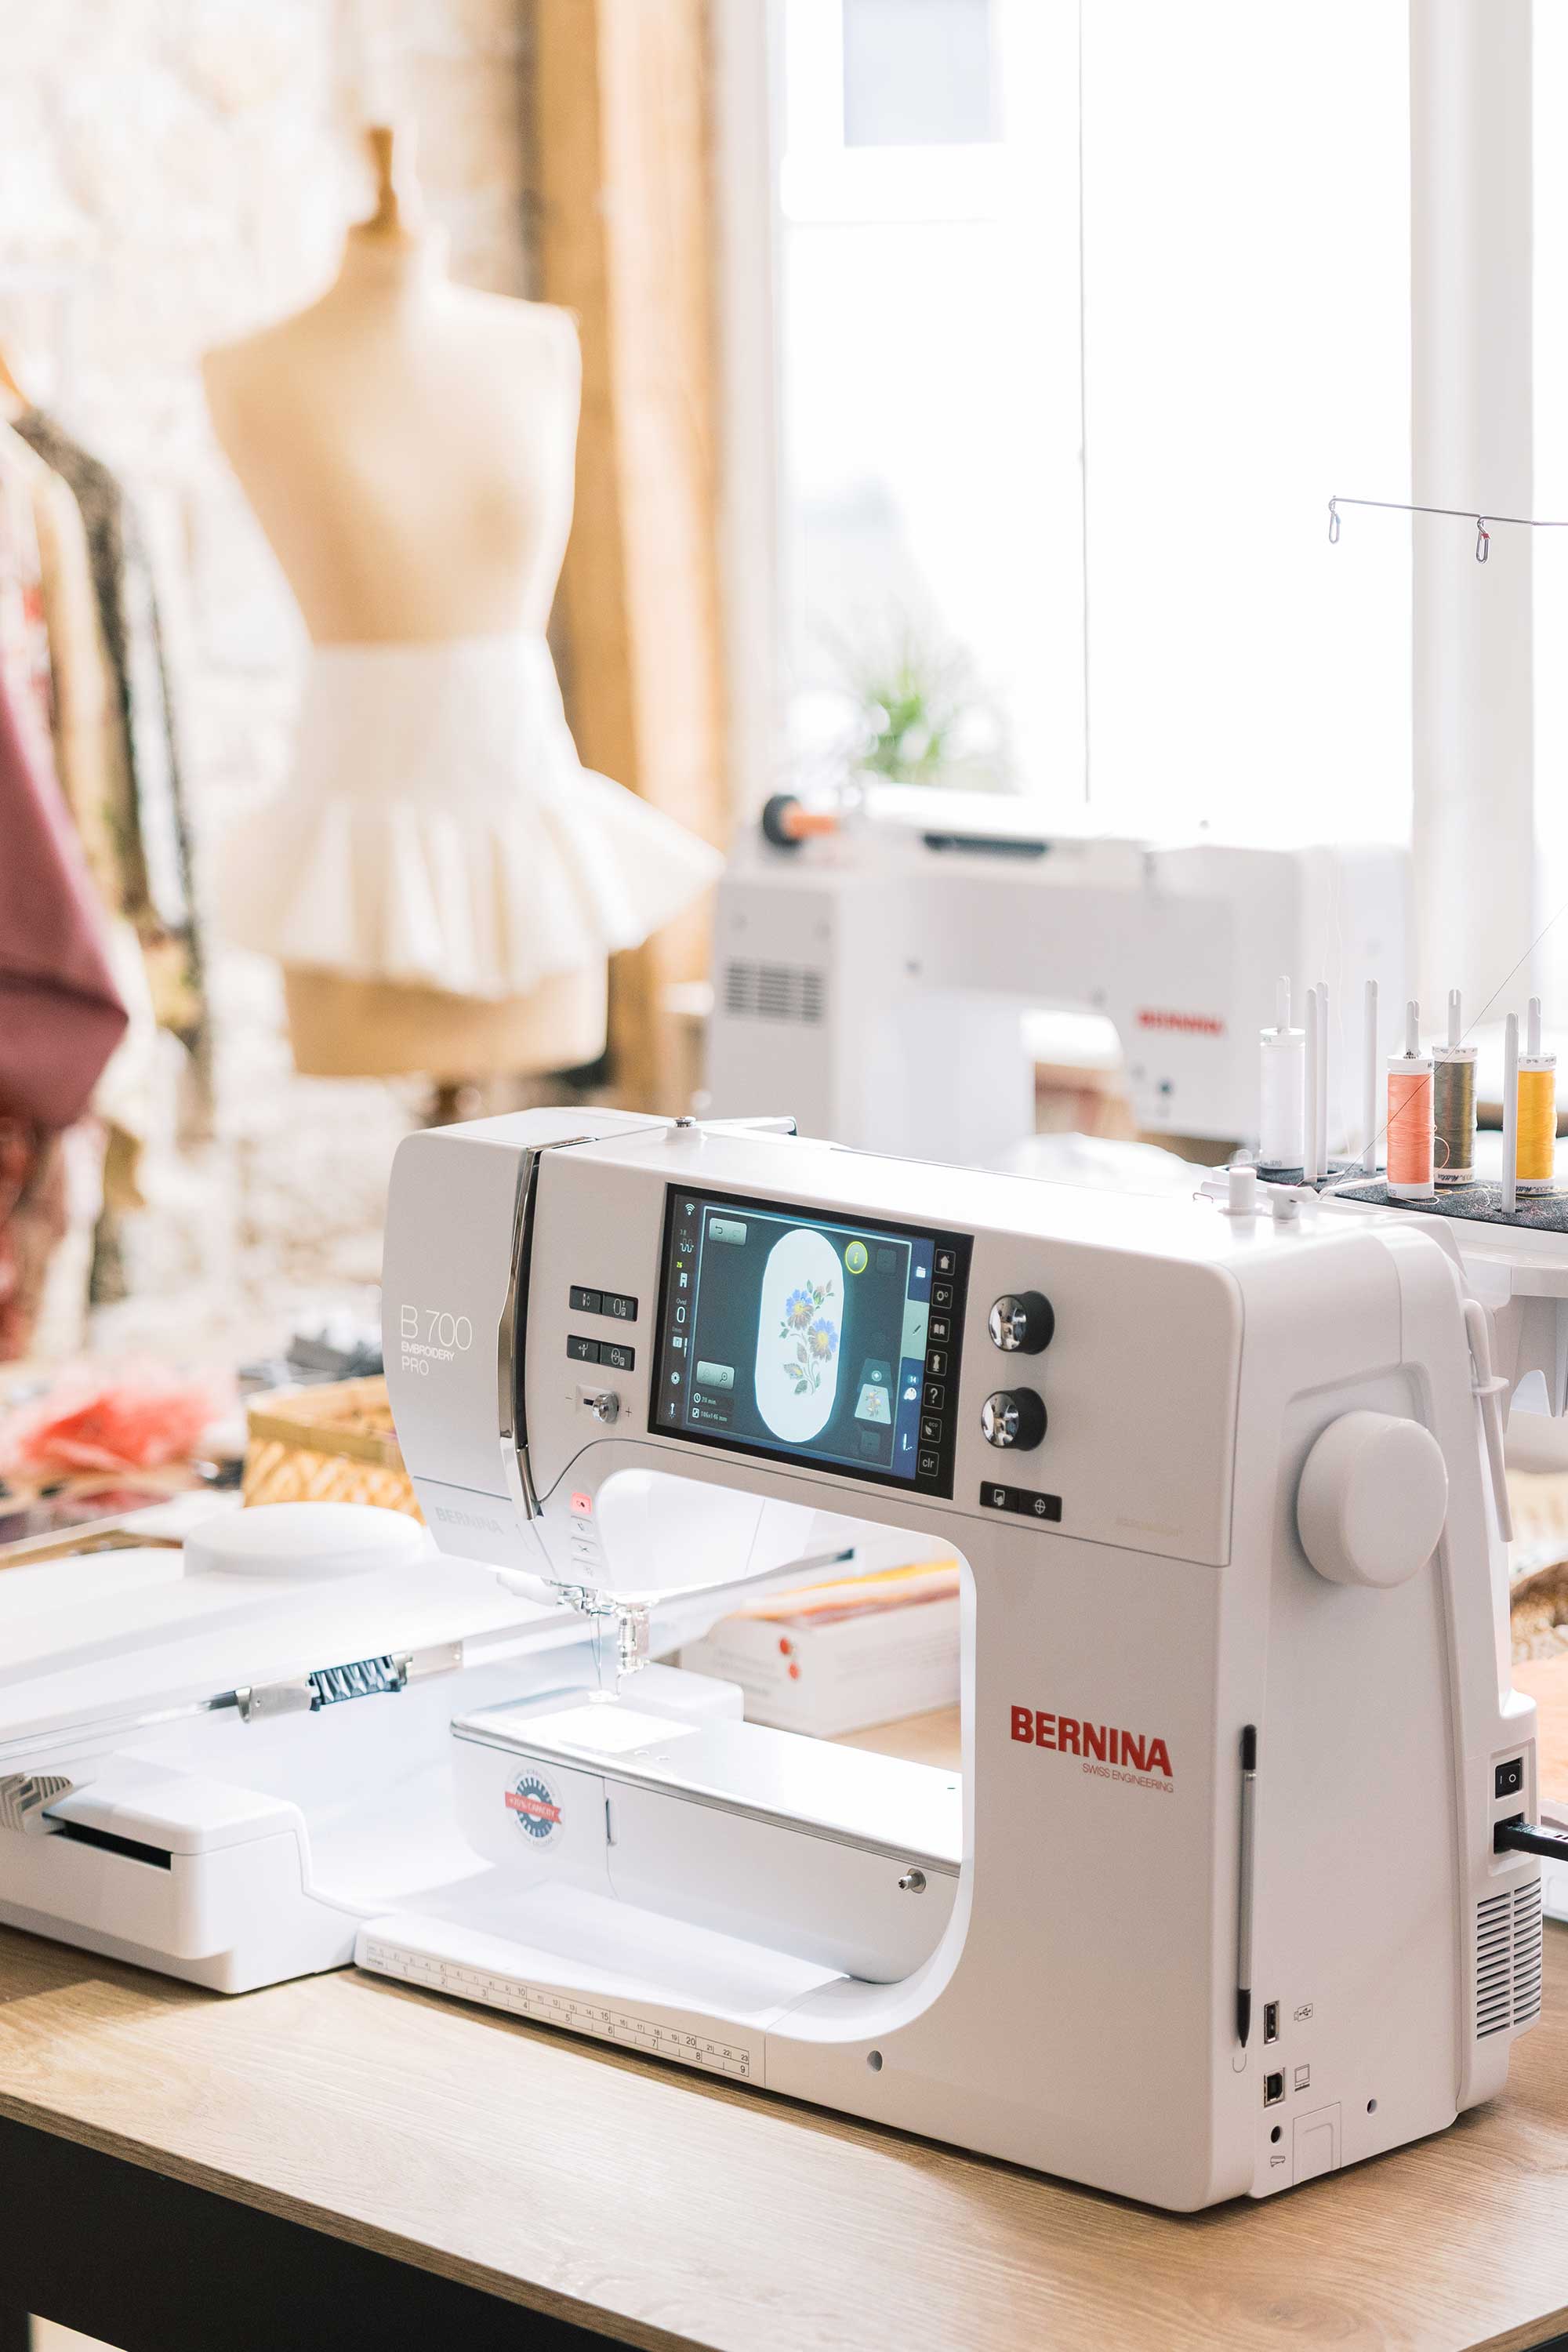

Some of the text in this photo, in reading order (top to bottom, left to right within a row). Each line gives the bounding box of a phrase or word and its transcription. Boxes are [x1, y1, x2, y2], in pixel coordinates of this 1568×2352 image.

[401, 1304, 473, 1350] B 700
[401, 1340, 455, 1362] EMBROIDERY
[401, 1355, 430, 1376] PRO
[922, 1457, 935, 1469] clr
[1011, 1704, 1174, 1777] BERNINA
[1082, 1762, 1174, 1793] SWISS ENGINEERING
[518, 1987, 526, 1996] 10
[601, 2011, 609, 2021] 15
[685, 2036, 695, 2046] 20
[565, 2013, 571, 2022] 5
[608, 2026, 613, 2034] 6
[652, 2038, 656, 2047] 7
[695, 2052, 701, 2060] 8
[740, 2064, 746, 2074] 9
